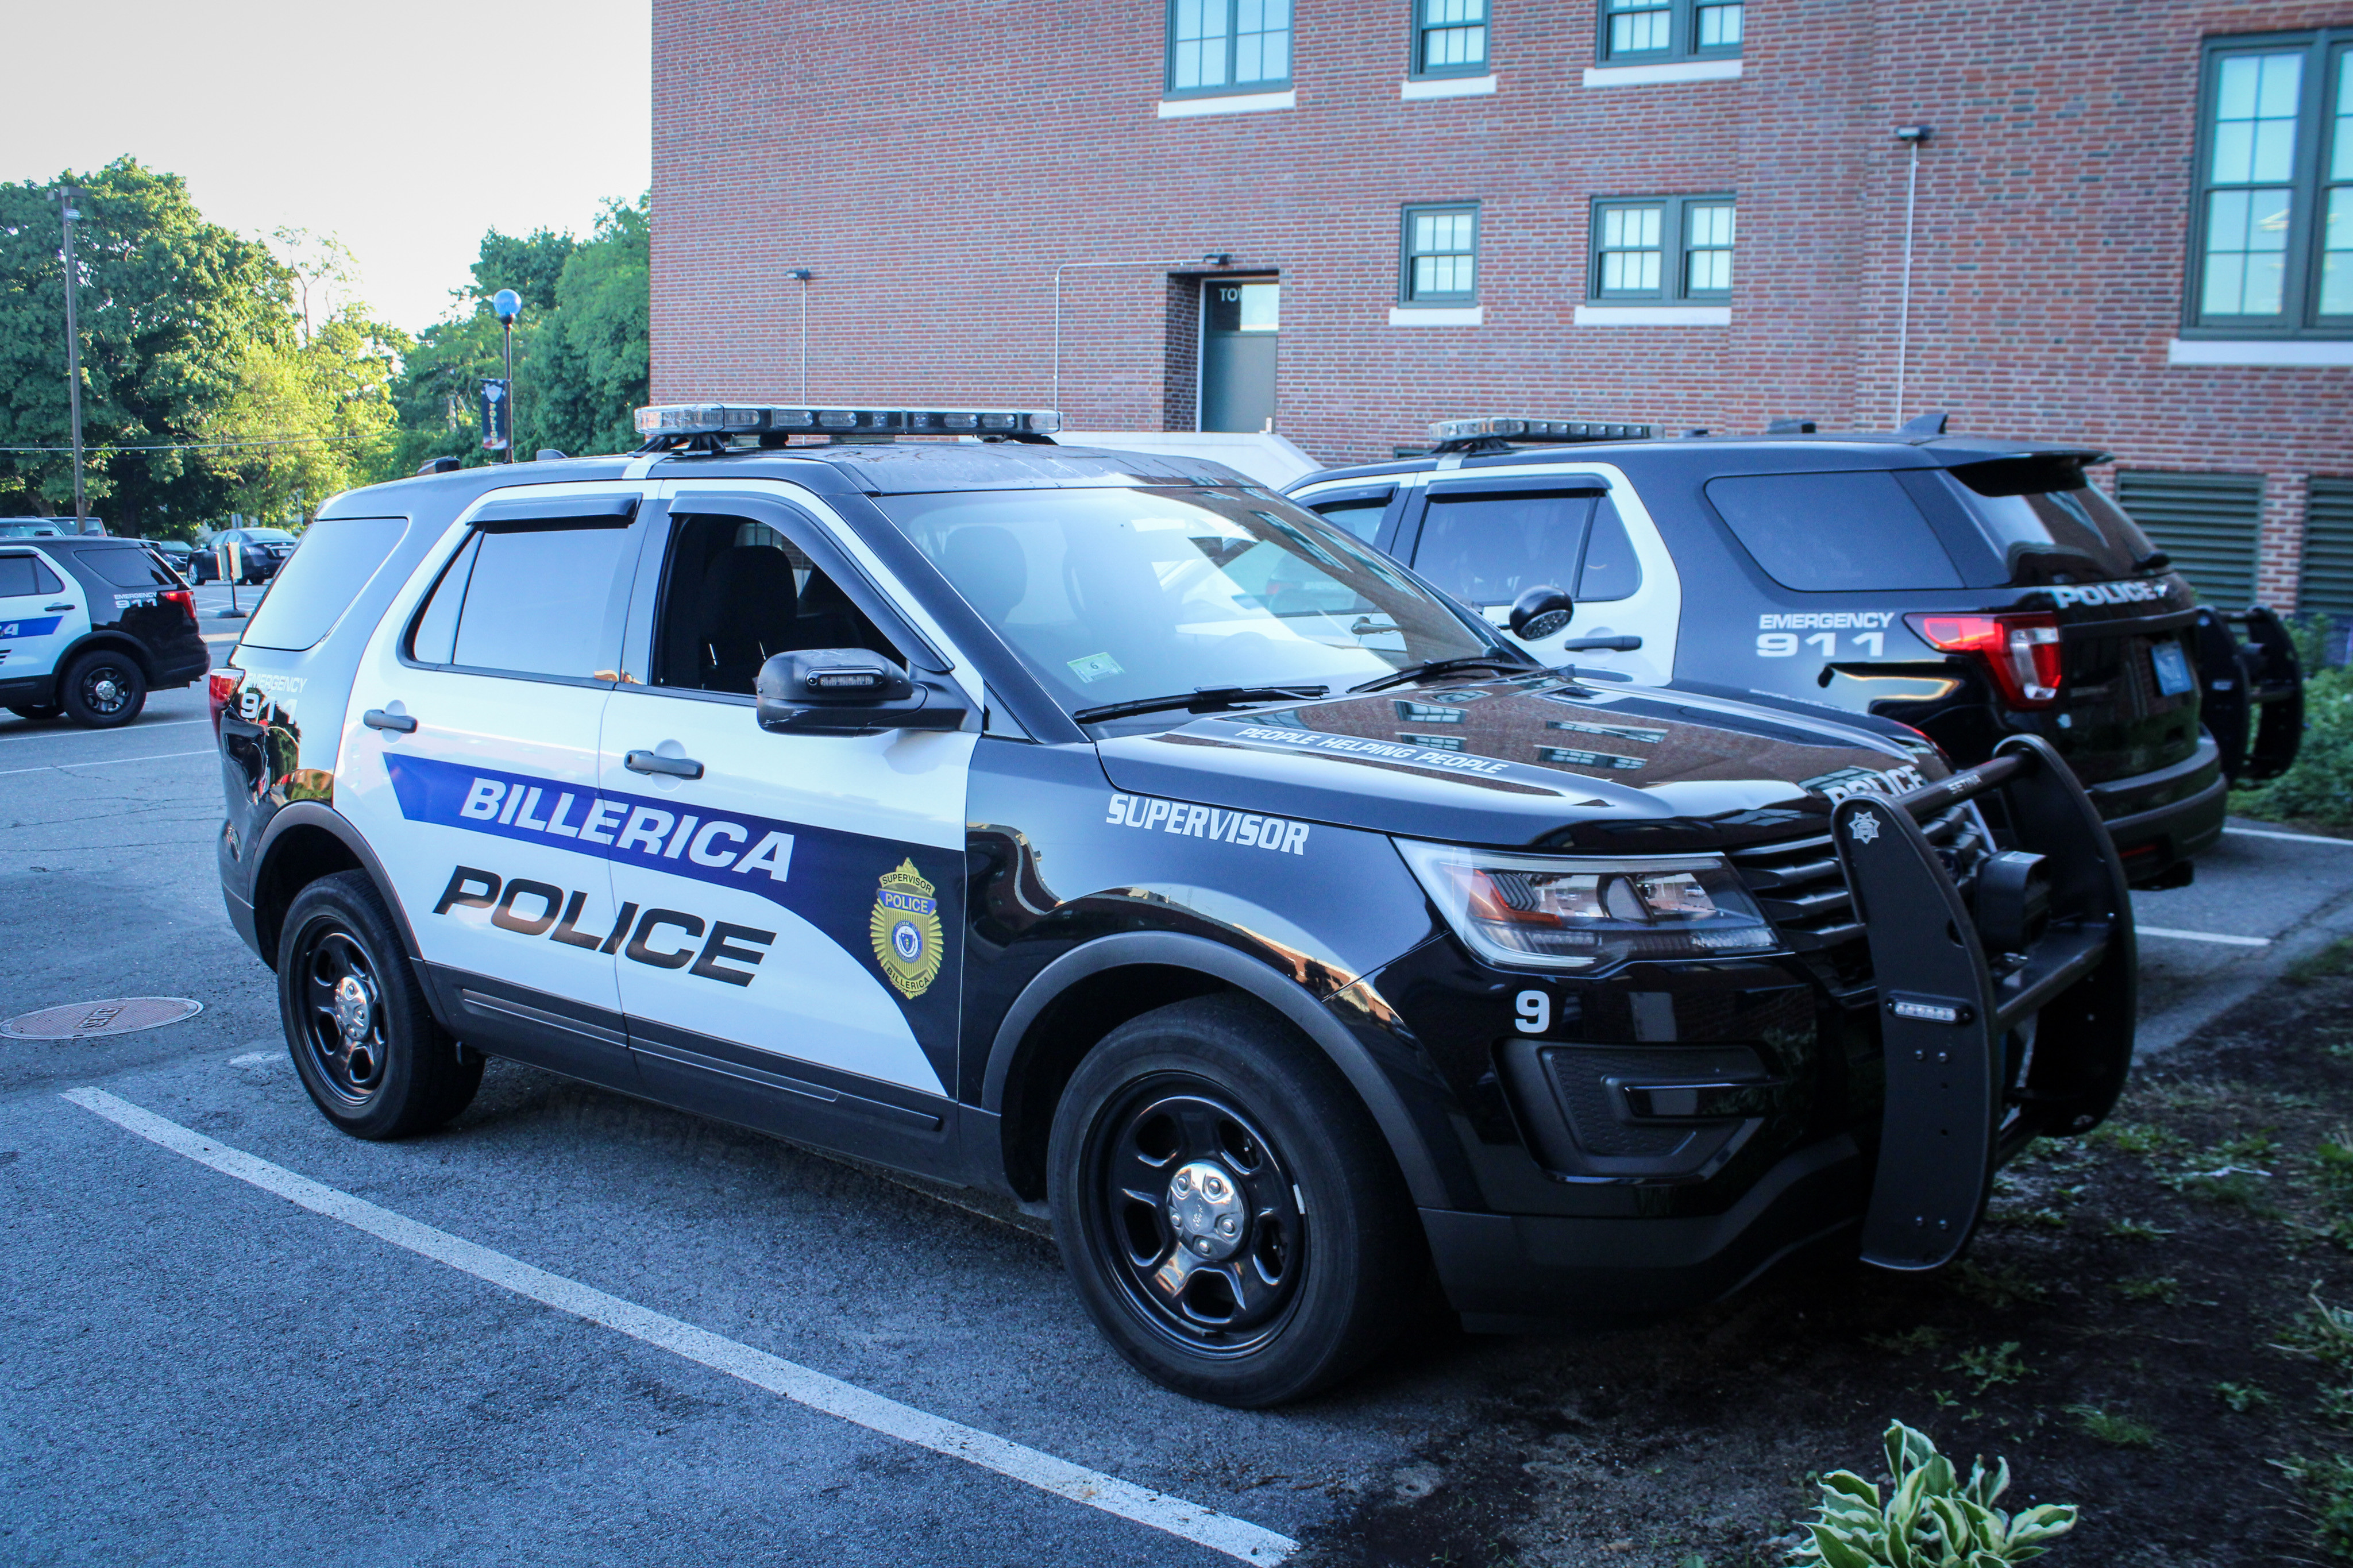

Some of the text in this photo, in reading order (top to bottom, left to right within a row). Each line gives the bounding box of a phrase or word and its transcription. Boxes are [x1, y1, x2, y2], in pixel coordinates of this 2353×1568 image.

[489, 403, 499, 445] POLICE
[114, 592, 158, 601] EMERGENCY
[115, 598, 158, 609] 911
[2050, 581, 2158, 609] POLICE
[1758, 611, 1895, 629] EMERGENCY
[1756, 632, 1885, 658] 911
[245, 672, 308, 694] EMERGENCY
[240, 692, 298, 725] 911
[1235, 728, 1509, 774] PEOPLE HELPING PEOPLE
[460, 777, 795, 882] BILLERICA
[1106, 793, 1310, 856] SUPERVISOR
[882, 873, 932, 894] SUPERVISOR
[885, 893, 928, 913] POLICE
[433, 864, 777, 987] POLICE
[886, 966, 930, 990] BILLERICA
[1514, 990, 1550, 1033] 9
